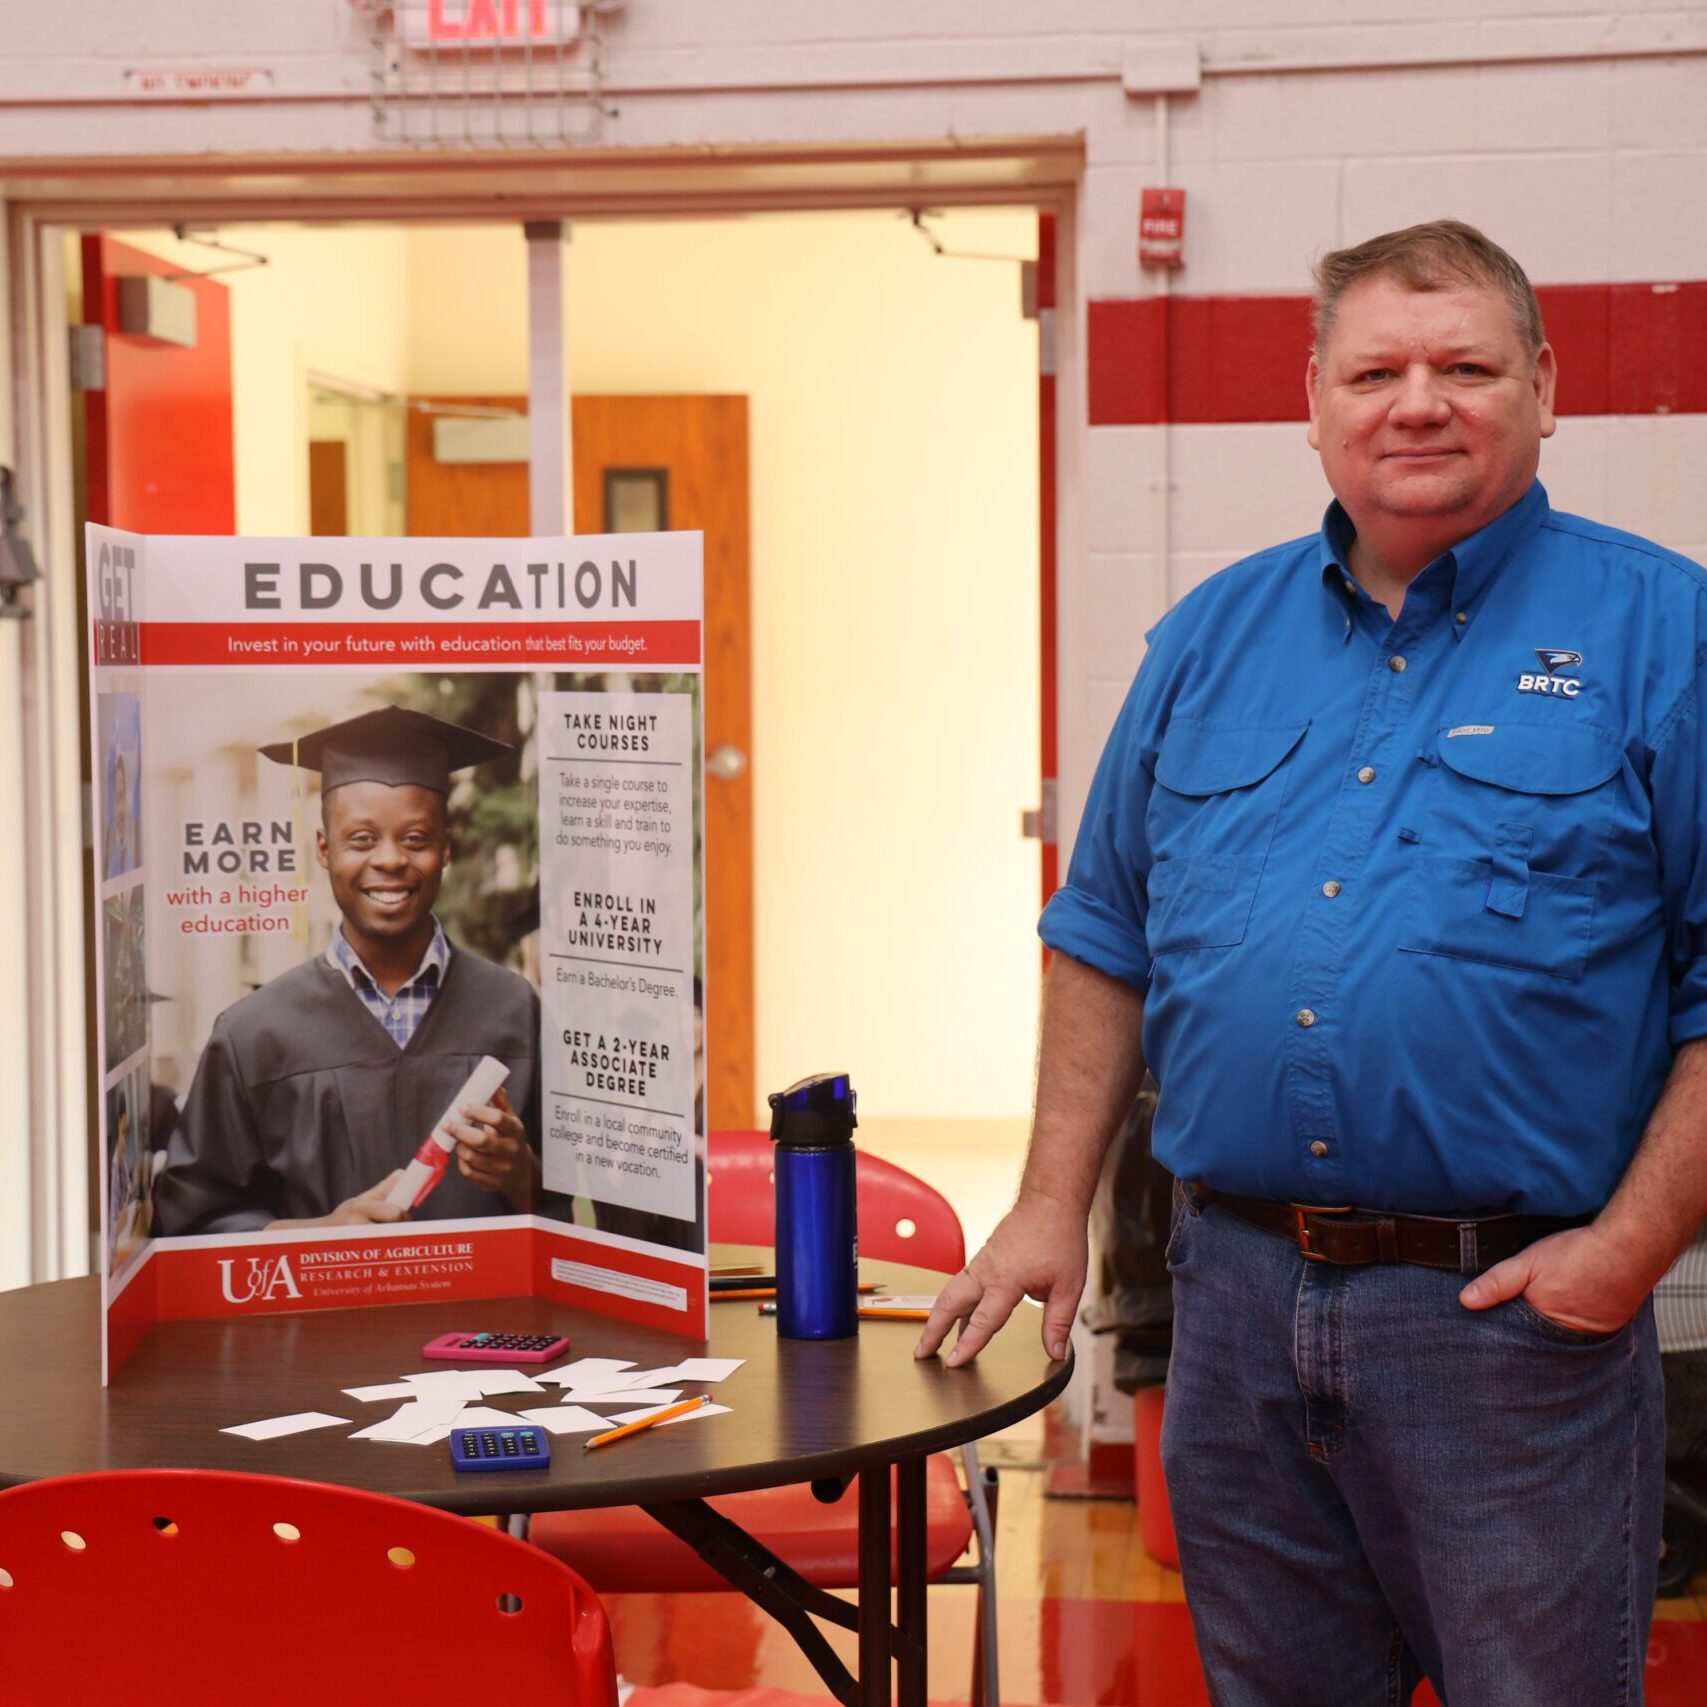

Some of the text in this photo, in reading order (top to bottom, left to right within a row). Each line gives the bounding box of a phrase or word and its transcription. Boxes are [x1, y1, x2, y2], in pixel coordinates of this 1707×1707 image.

[99, 542, 135, 622] GET
[244, 560, 637, 610] EDUCATION
[100, 625, 136, 658] REAL
[228, 635, 648, 656] Invest in your future with education that best fits your budget.
[1517, 675, 1582, 697] BRTC
[564, 713, 658, 732] TAKE NIGHT
[577, 734, 650, 751] COURSES
[559, 773, 668, 793] Take a single course to
[559, 792, 672, 815] increase your expertise,
[185, 821, 292, 846] EARN
[560, 812, 671, 833] learn a skill and train to
[556, 831, 673, 857] do something you enjoy.
[183, 849, 296, 874] MORE
[167, 884, 309, 908] with a higher
[574, 892, 656, 914] ENROLL IN
[181, 914, 289, 933] education
[579, 912, 651, 934] A 4-YEAR
[568, 930, 663, 955] UNIVERSITY
[556, 967, 679, 999] Earn a Bachelor's Degree.
[563, 1030, 670, 1061] GET A 2-YEAR
[570, 1050, 657, 1078] ASSOCIATE
[586, 1072, 646, 1096] DEGREE
[555, 1105, 682, 1146] Enroll in a local community
[549, 1126, 689, 1164] college and become certified
[576, 1148, 662, 1179] in a new vocation.
[300, 1243, 473, 1265] DIVISION OF AGRICULTURE
[300, 1262, 474, 1283] RESEARCH & EXTENSION
[313, 1287, 360, 1298] University
[364, 1285, 373, 1295] of
[419, 1280, 451, 1291] System
